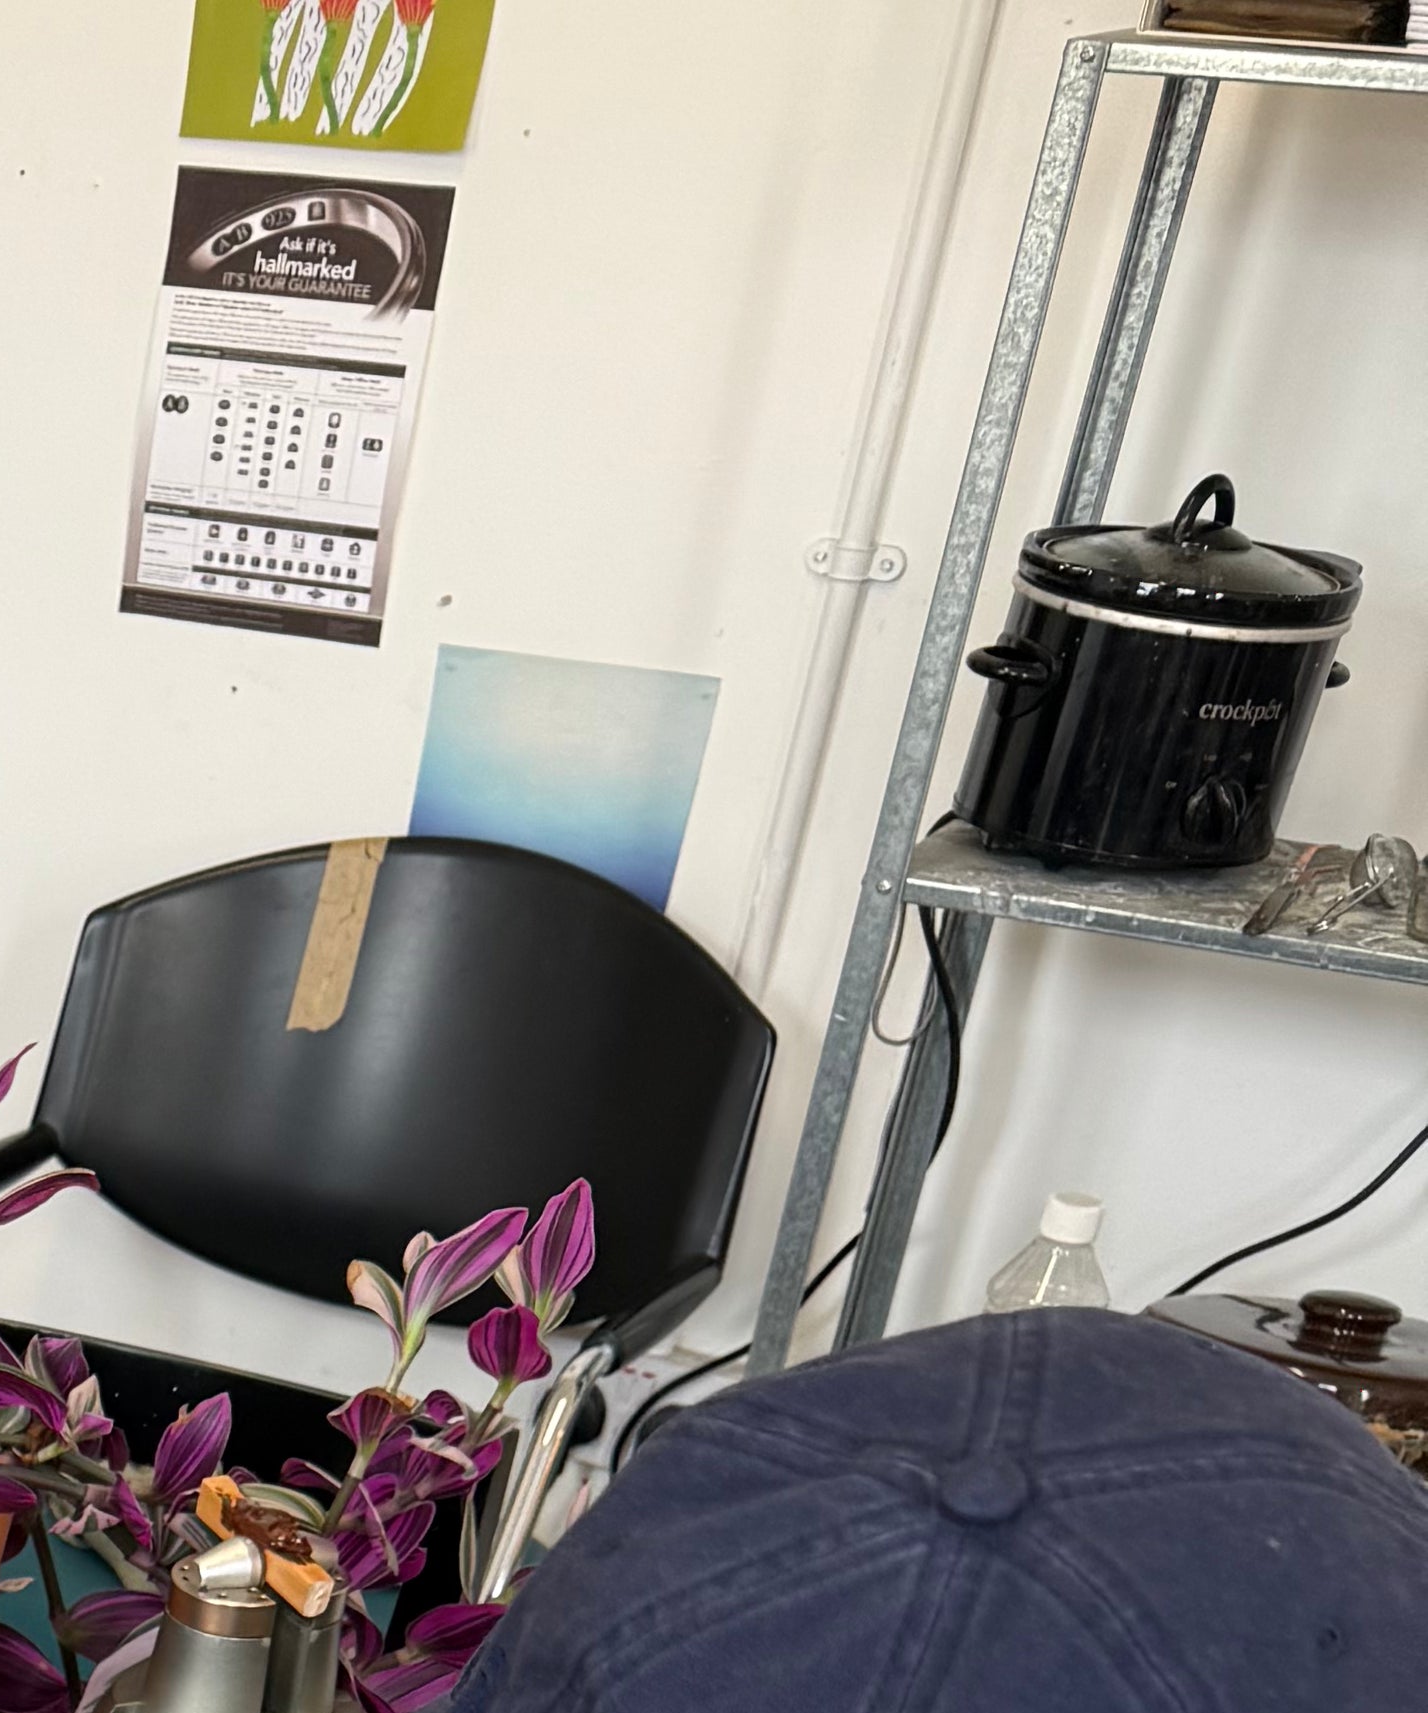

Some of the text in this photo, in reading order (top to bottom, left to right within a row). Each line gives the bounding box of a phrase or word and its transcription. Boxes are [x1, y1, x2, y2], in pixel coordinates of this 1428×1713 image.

[278, 236, 337, 256] Ask if it's
[253, 251, 357, 281] hallmarked
[222, 272, 372, 299] IT'S YOUR GUARANTEE
[1199, 698, 1283, 727] crockpot
